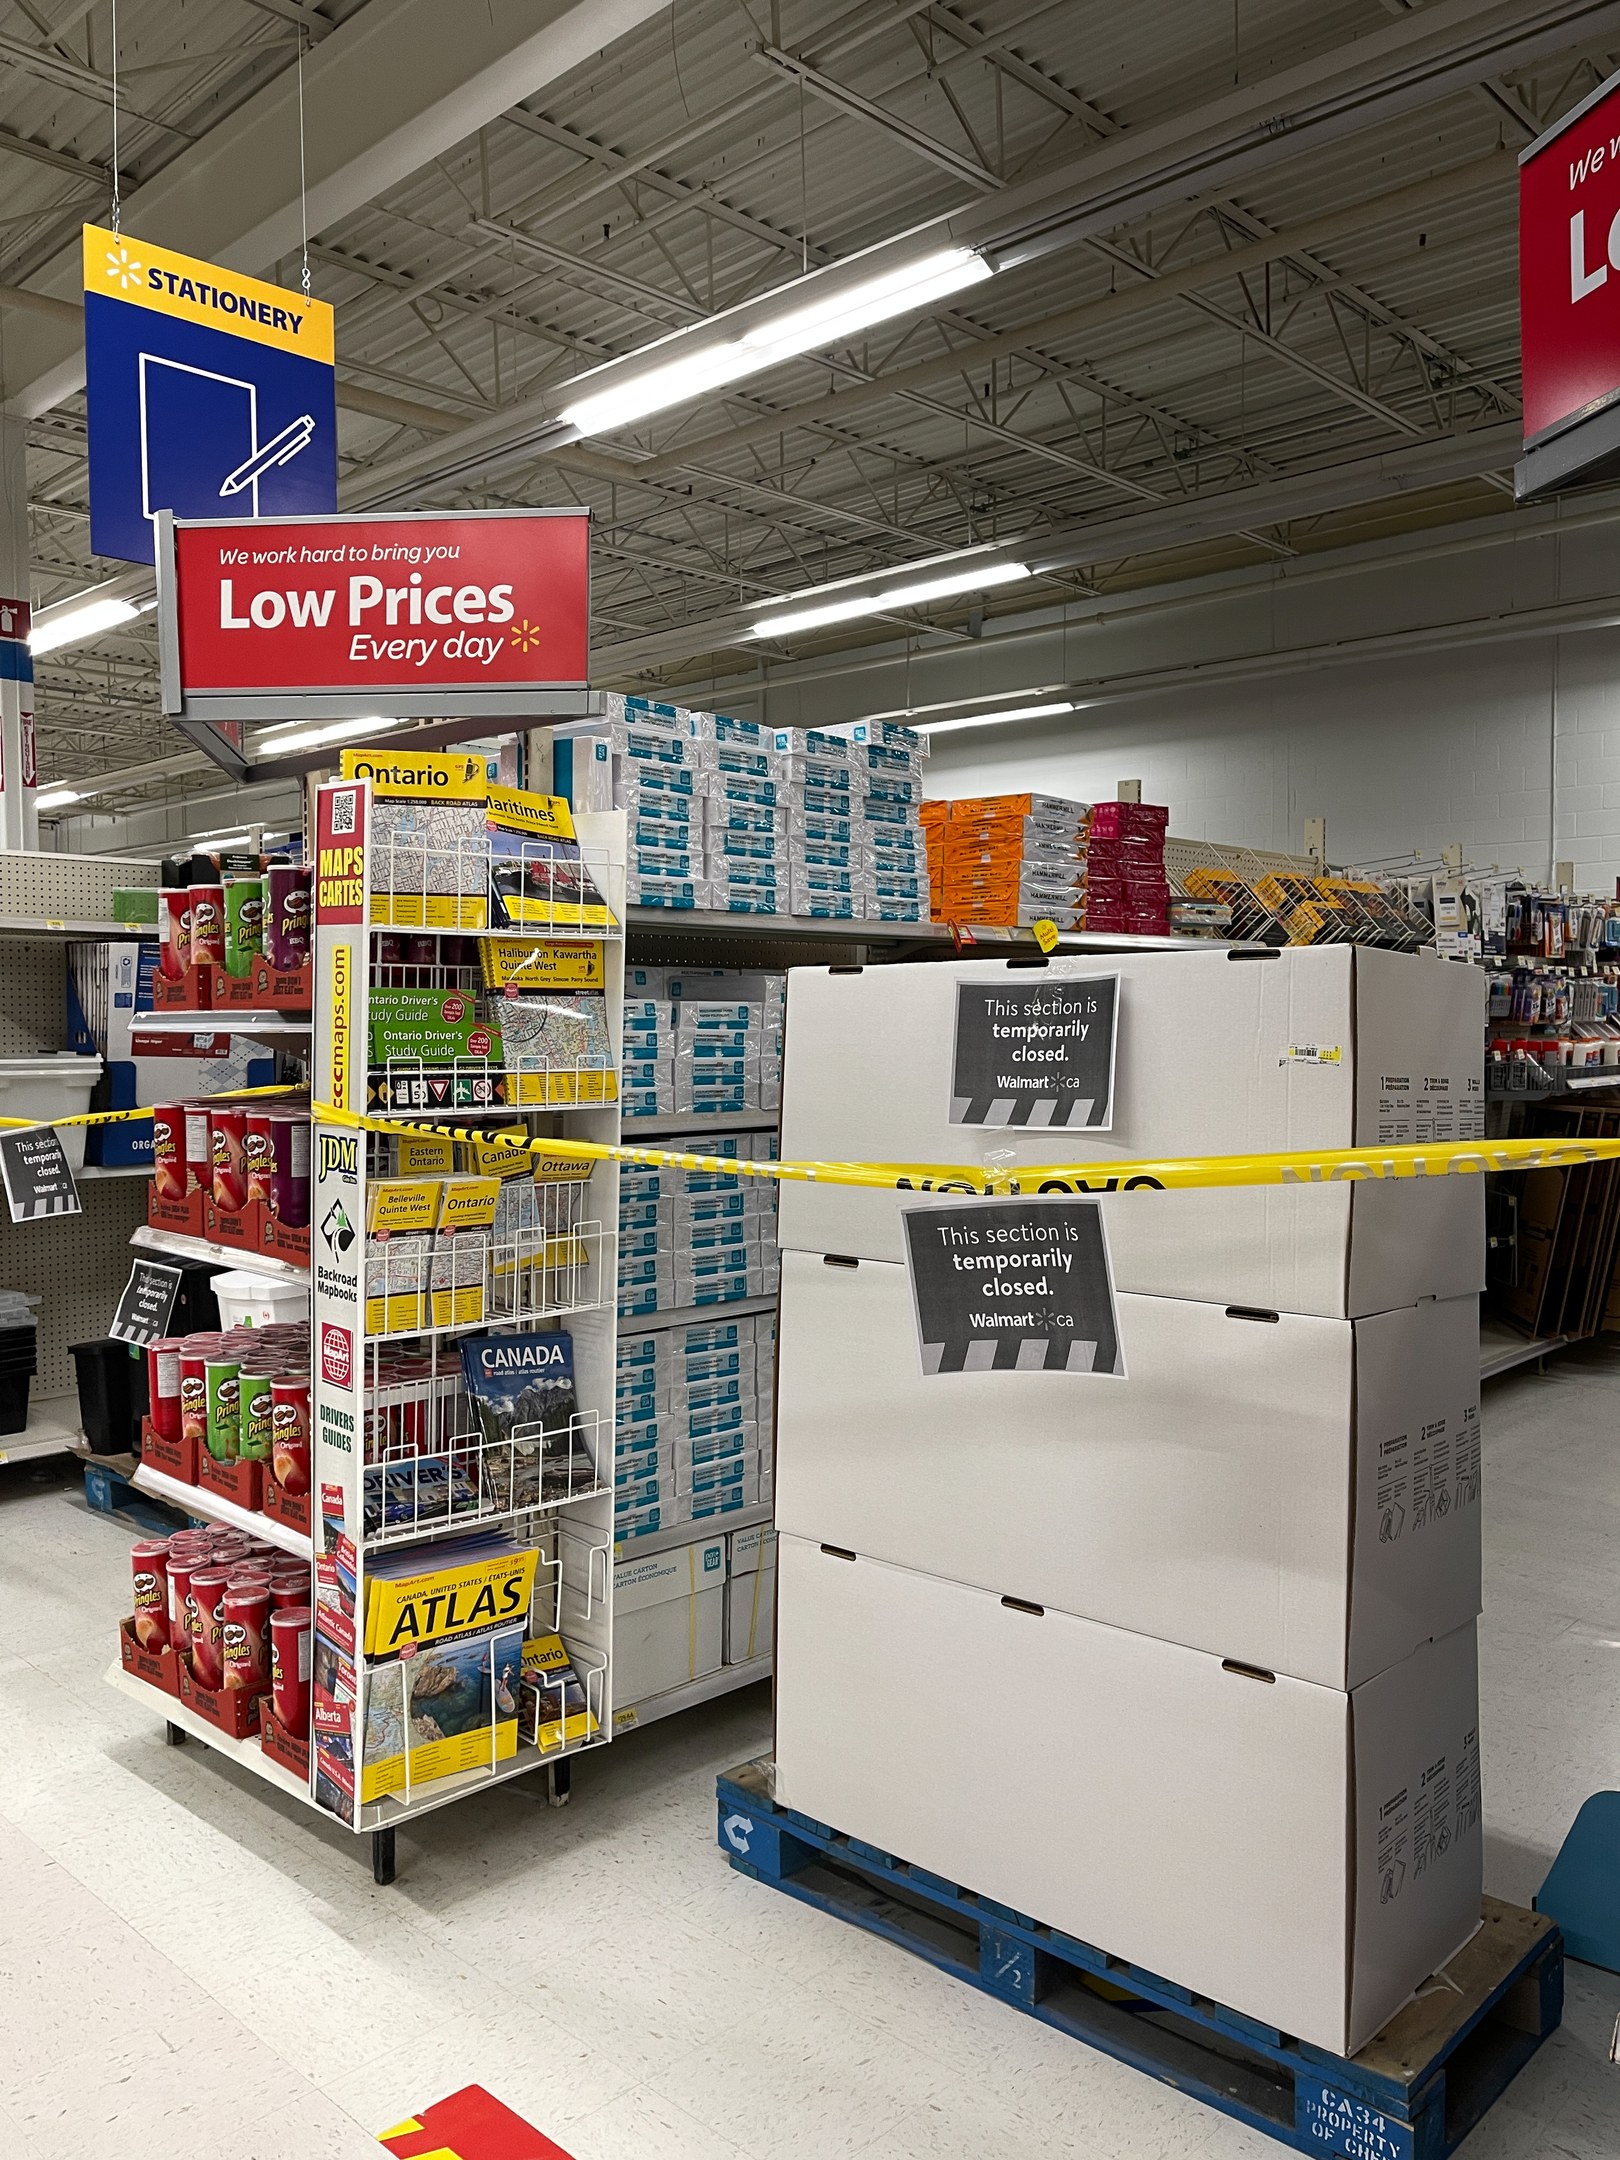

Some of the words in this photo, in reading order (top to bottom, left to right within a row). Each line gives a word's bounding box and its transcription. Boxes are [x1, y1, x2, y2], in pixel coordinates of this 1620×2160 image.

[1569, 146, 1605, 191] We
[1570, 208, 1620, 304] L
[148, 267, 303, 335] STATIONERY
[219, 548, 249, 566] We
[252, 545, 296, 565] work
[300, 544, 345, 563] hard
[349, 546, 367, 562] to
[371, 542, 420, 568] bring
[424, 546, 460, 567] you
[220, 579, 336, 629] Low
[349, 572, 515, 627] Prices
[350, 634, 437, 666] Every
[443, 629, 504, 666] day
[354, 762, 449, 787] Ontario
[1042, 802, 1075, 814] HAMMERMILL
[320, 847, 363, 877] MAPS
[319, 878, 363, 908] CARTES
[1030, 893, 1067, 902] HAMMERMILL
[1040, 926, 1054, 940] Multi
[1043, 934, 1056, 946] Save
[498, 947, 549, 959] Haliburon
[553, 949, 597, 960] Kawartha
[534, 961, 557, 971] West
[401, 995, 438, 1006] Driver's
[985, 999, 1018, 1017] This
[1023, 996, 1083, 1016] section
[1086, 995, 1097, 1014] is
[395, 1008, 429, 1021] Guide
[383, 1030, 422, 1041] Ontario
[424, 1030, 463, 1041] Driver's
[992, 1019, 1089, 1042] temporarily
[385, 1044, 418, 1057] Study
[420, 1043, 455, 1056] Guide
[1011, 1045, 1069, 1063] closed.
[997, 1074, 1049, 1090] Walmart
[1066, 1076, 1080, 1089] ca
[1424, 1077, 1429, 1091] 2
[1467, 1078, 1472, 1091] 3
[15, 1140, 34, 1153] This
[410, 1147, 443, 1157] Eastern
[319, 1133, 358, 1184] JDM
[409, 1157, 445, 1167] Ontario
[541, 1161, 590, 1172] Ottawa
[37, 1163, 61, 1177] closed.
[33, 1182, 58, 1194] Walmart
[388, 1193, 426, 1204] Belleville
[447, 1195, 495, 1210] Ontario
[379, 1205, 408, 1215] Quinte
[409, 1203, 431, 1212] West
[937, 1226, 981, 1247] This
[985, 1223, 1061, 1245] section
[1064, 1222, 1079, 1241] is
[953, 1250, 1073, 1275] temporarily
[317, 1265, 358, 1288] Backroad
[317, 1280, 358, 1303] Mapbooks
[982, 1278, 1054, 1297] closed.
[969, 1312, 1034, 1328] Walmart
[1056, 1315, 1075, 1328] ca
[323, 1344, 350, 1363] MapArt
[480, 1344, 565, 1369] CANADA
[320, 1403, 355, 1433] DRIVERS
[322, 1426, 352, 1454] GUIDES
[1421, 1426, 1426, 1441] 2
[321, 1492, 343, 1506] Canada
[737, 1532, 755, 1544] VALUE
[736, 1541, 759, 1553] CARTON
[316, 1561, 336, 1573] Ontario
[633, 1563, 658, 1575] CARTON
[637, 1566, 677, 1583] ÉCONOMIQUE
[394, 1576, 435, 1589] MapArt.com
[430, 1583, 457, 1596] UNITED
[458, 1577, 483, 1589] STATES
[488, 1567, 525, 1582] ÉTATS-UNIS
[388, 1576, 523, 1646] ATLAS
[434, 1636, 453, 1645] ROAD
[453, 1631, 473, 1641] ATLAS
[475, 1625, 494, 1635] ATLAS
[494, 1617, 518, 1630] ROUTIER
[315, 1707, 341, 1723] Alberta
[1321, 2088, 1386, 2134] CA34
[1306, 2099, 1401, 2158] PROPERTY
[1311, 2122, 1335, 2141] OF
